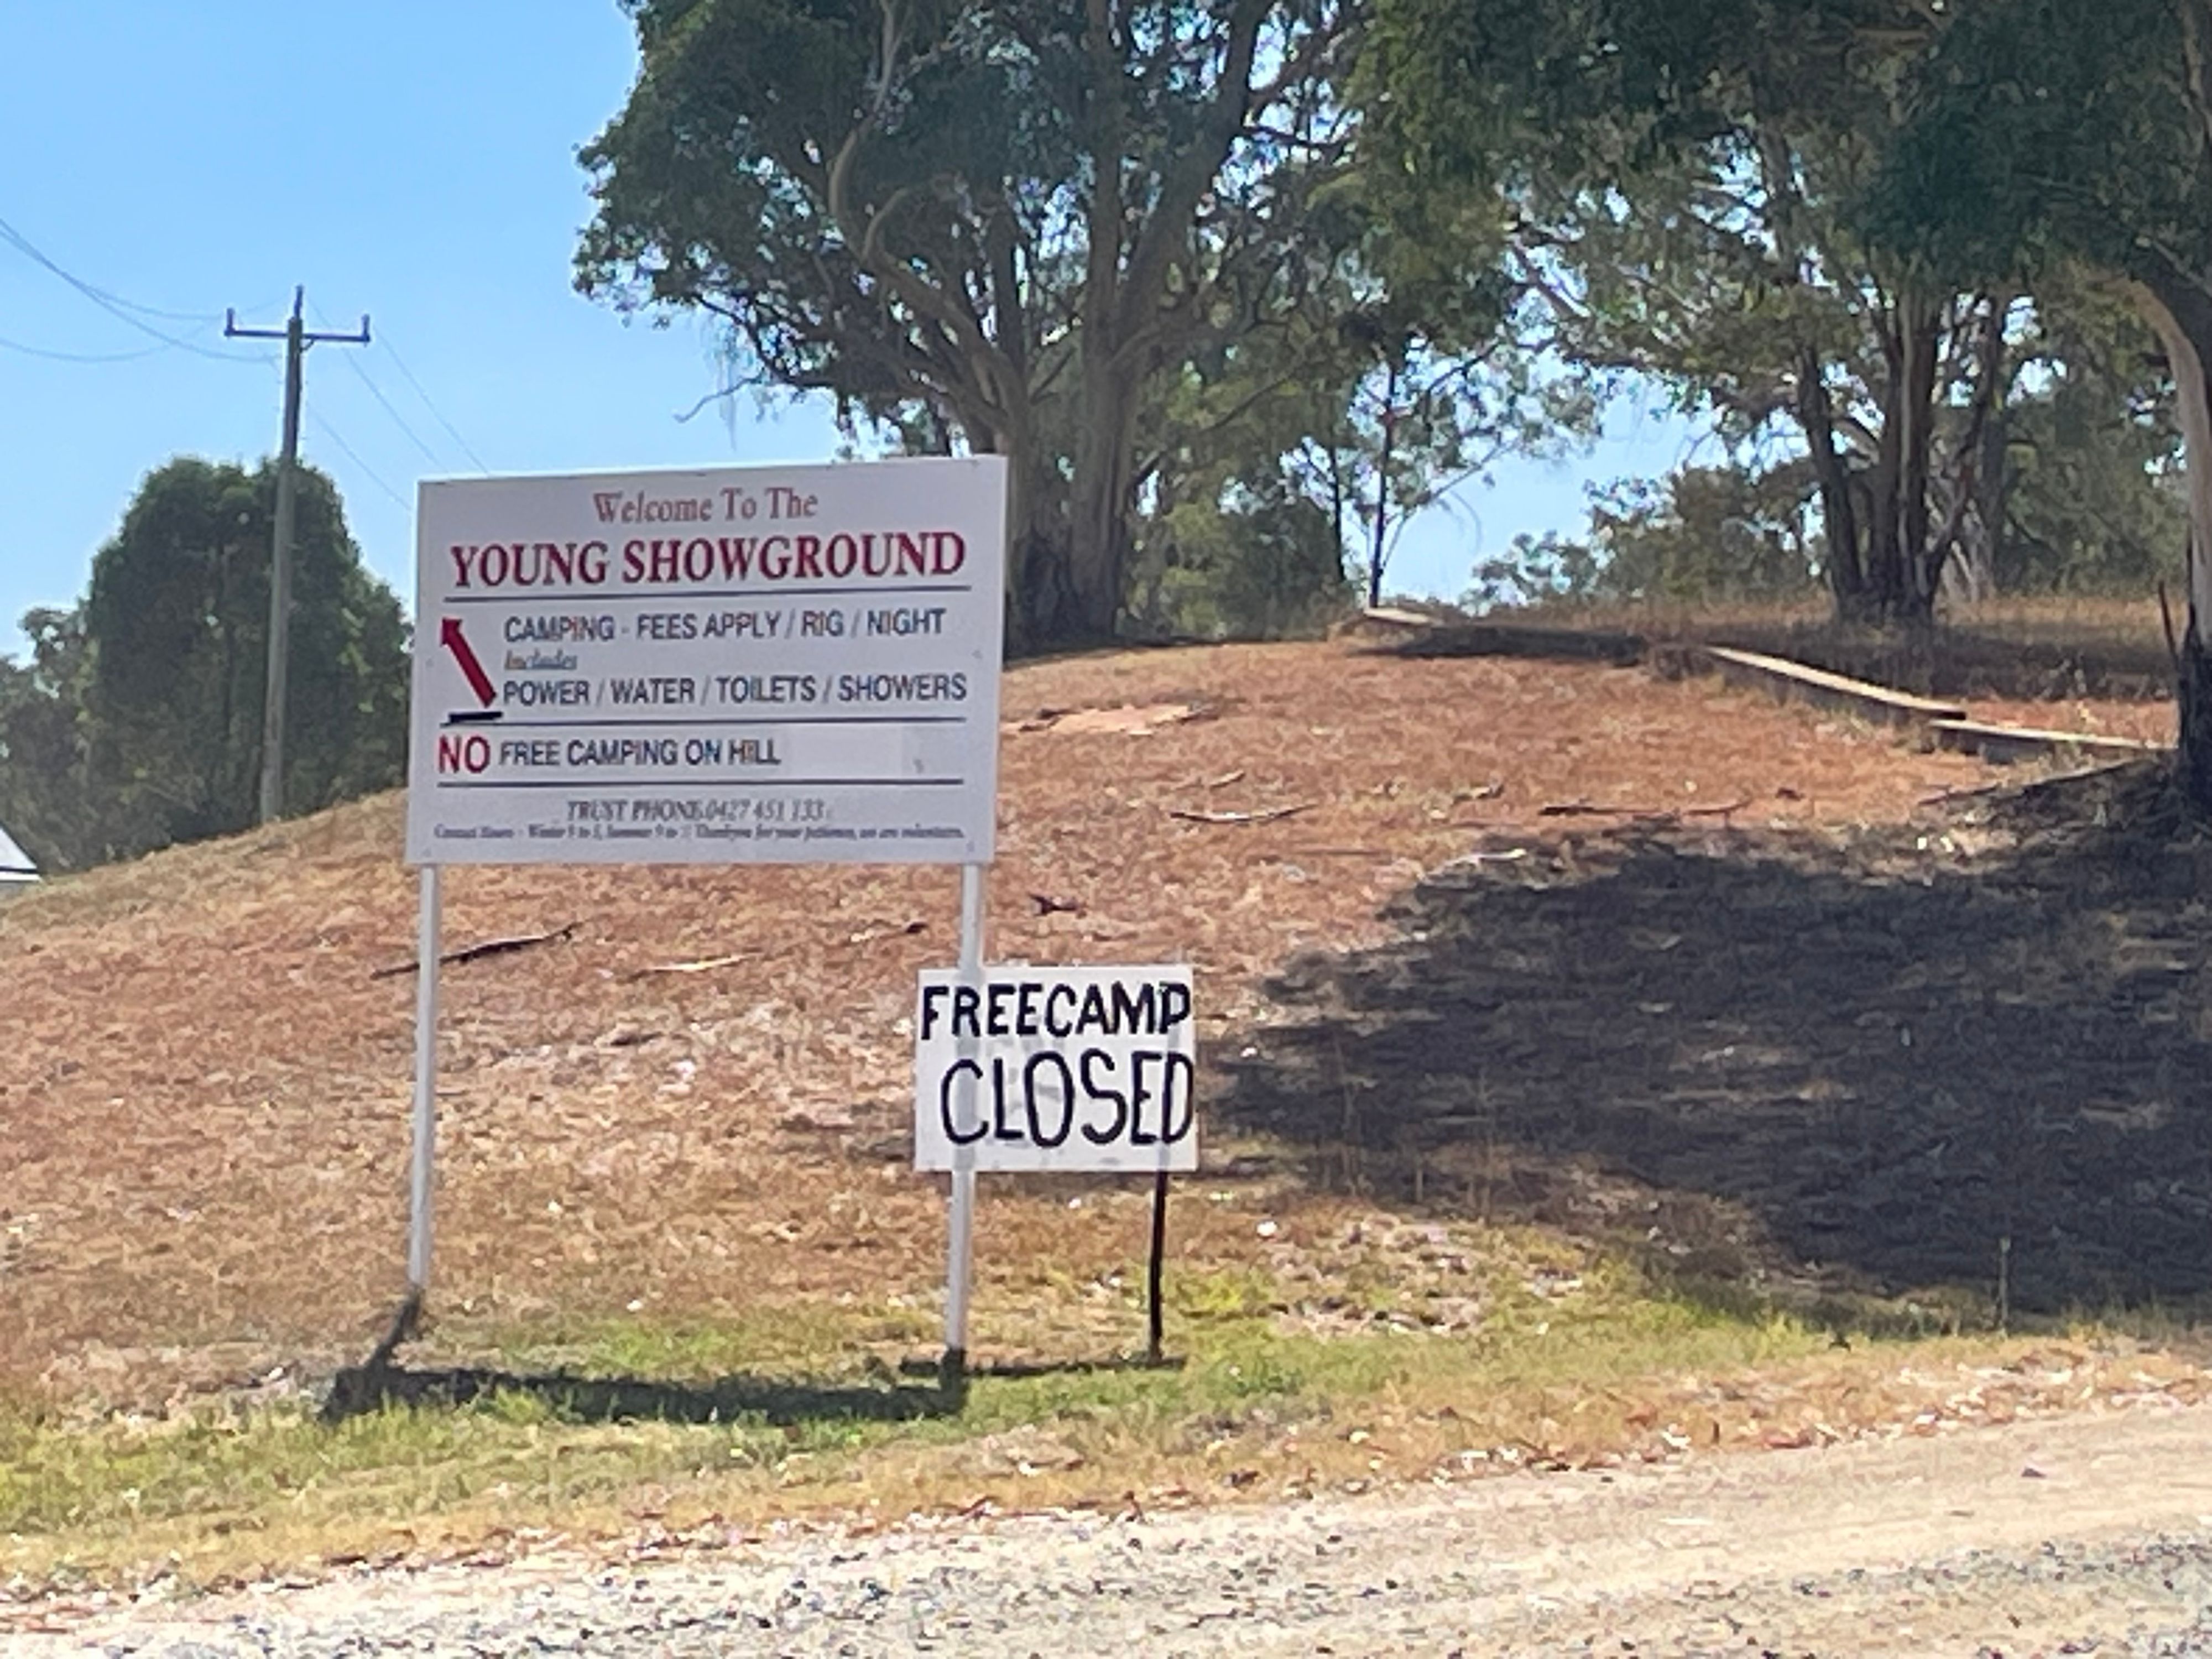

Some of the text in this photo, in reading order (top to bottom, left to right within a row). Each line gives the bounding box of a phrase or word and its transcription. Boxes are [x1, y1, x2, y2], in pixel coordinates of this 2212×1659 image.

[593, 486, 818, 524] Welcome To The
[450, 531, 966, 587] YOUNG SHOWGROUND
[504, 615, 615, 643] CAMPING
[636, 613, 697, 641] FEES
[703, 611, 781, 639] APPLY
[801, 609, 844, 637] RIG
[867, 607, 947, 636] NIGHT
[503, 679, 590, 707] POWER
[611, 677, 696, 706] WATER
[716, 674, 816, 703] TOILETS
[838, 672, 967, 702] SHOWERS
[439, 734, 782, 774] NO FREE CAMPING ON HILL
[941, 1047, 1194, 1149] CLOSED
